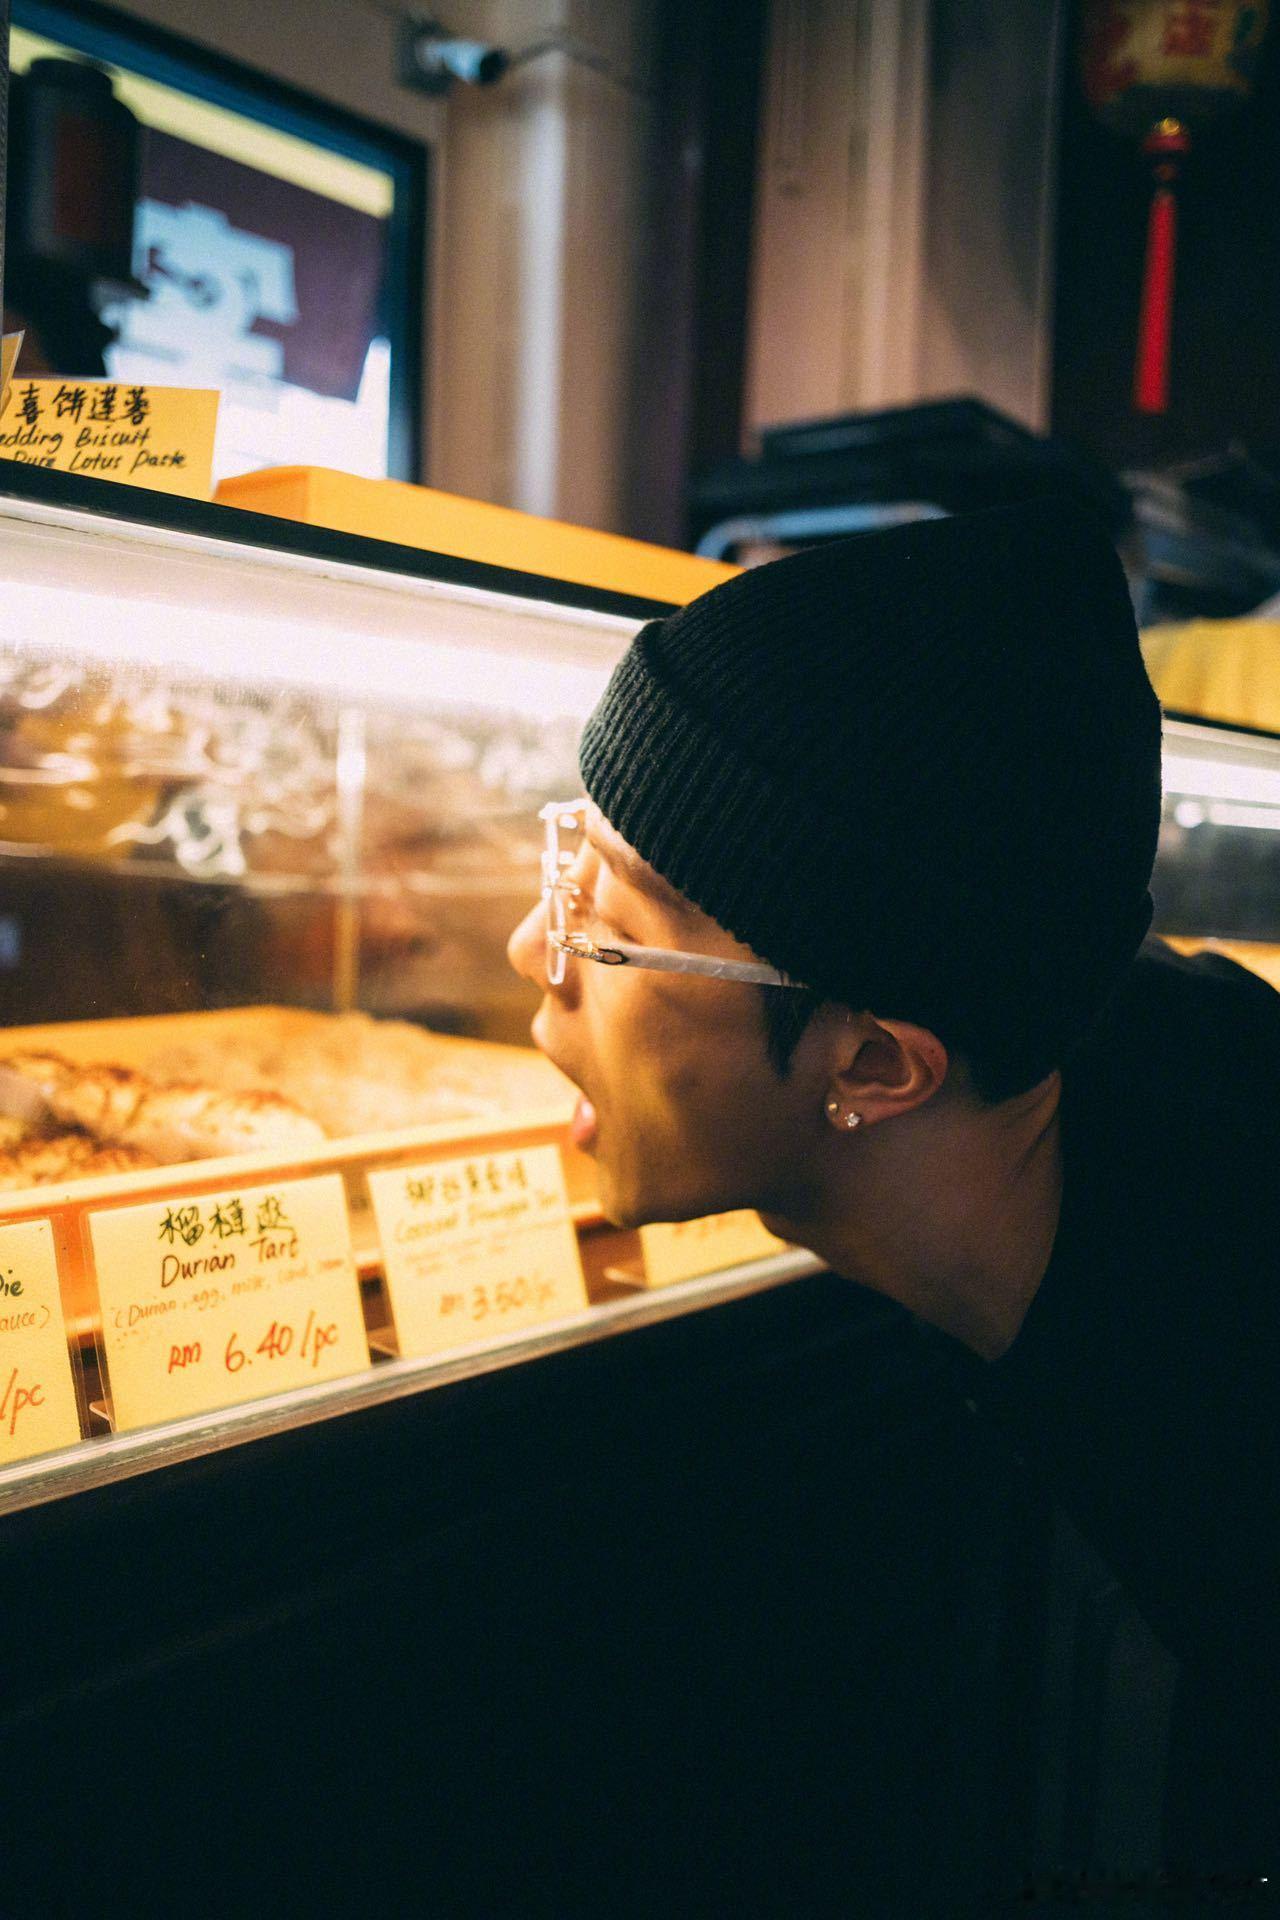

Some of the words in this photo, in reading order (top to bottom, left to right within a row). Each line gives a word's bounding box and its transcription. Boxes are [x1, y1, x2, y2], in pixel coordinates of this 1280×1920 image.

[75, 426, 150, 449] Biscuit
[69, 450, 122, 472] Lotus
[161, 1244, 236, 1288] Durian
[249, 1236, 300, 1263] Tart
